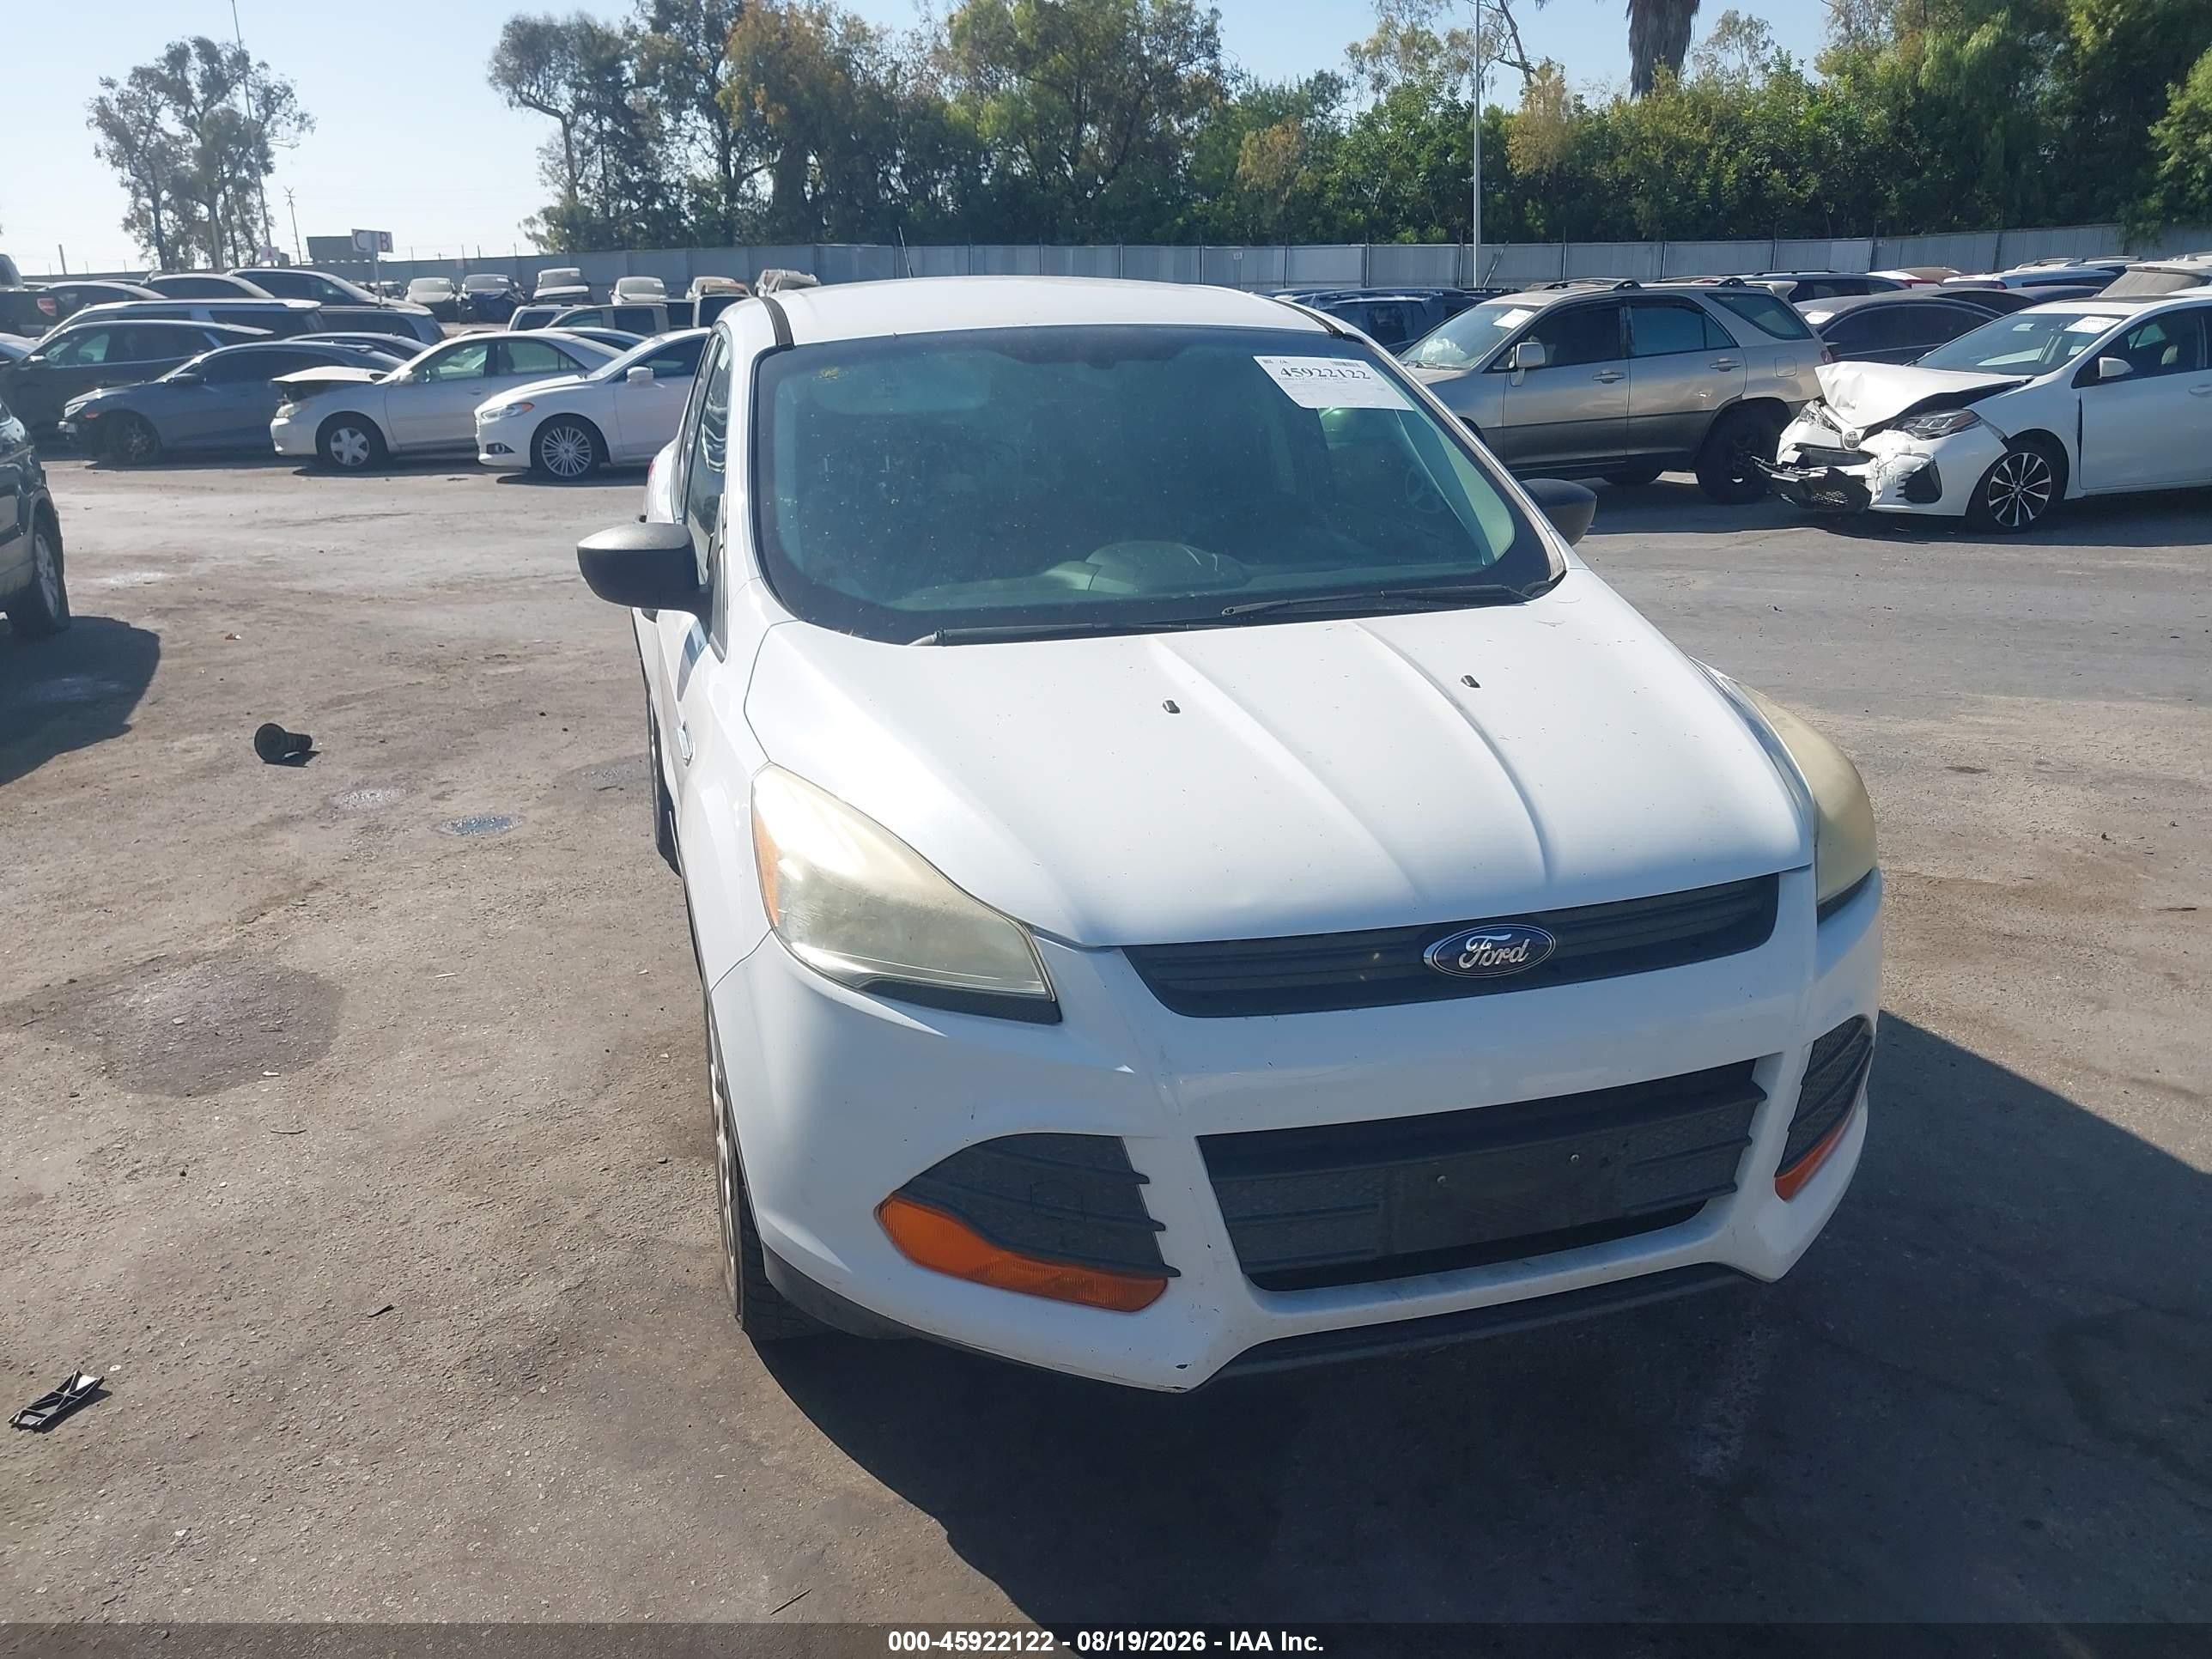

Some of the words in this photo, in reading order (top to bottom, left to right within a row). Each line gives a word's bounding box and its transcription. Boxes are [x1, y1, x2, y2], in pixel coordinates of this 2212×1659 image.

[355, 231, 366, 251] C
[380, 232, 390, 251] B
[1280, 368, 1371, 380] 45922122
[1458, 933, 1531, 969] Ford
